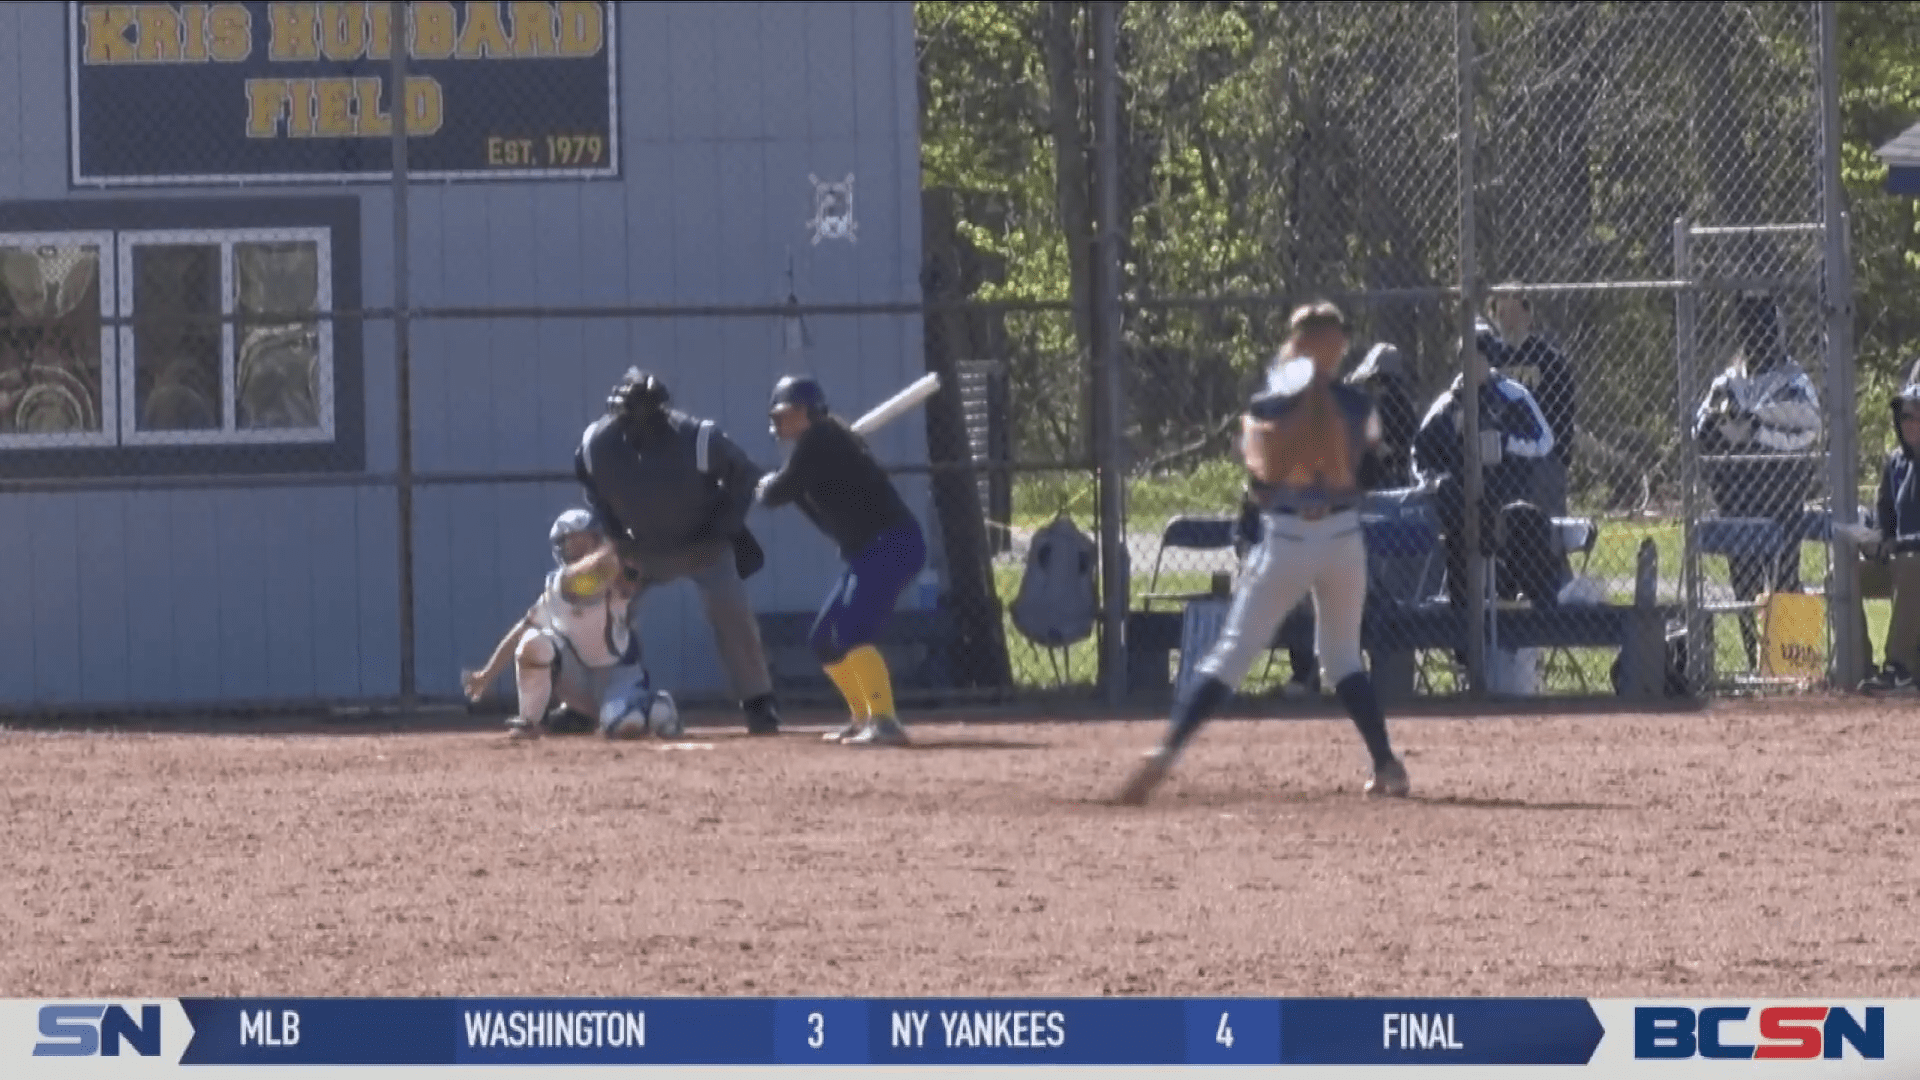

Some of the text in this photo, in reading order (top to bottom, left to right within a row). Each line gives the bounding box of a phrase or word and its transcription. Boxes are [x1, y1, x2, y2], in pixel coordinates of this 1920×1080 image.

[83, 1, 602, 65] KRIS HUBBARD
[245, 76, 443, 138] FIELD
[487, 135, 602, 166] EST. 1979
